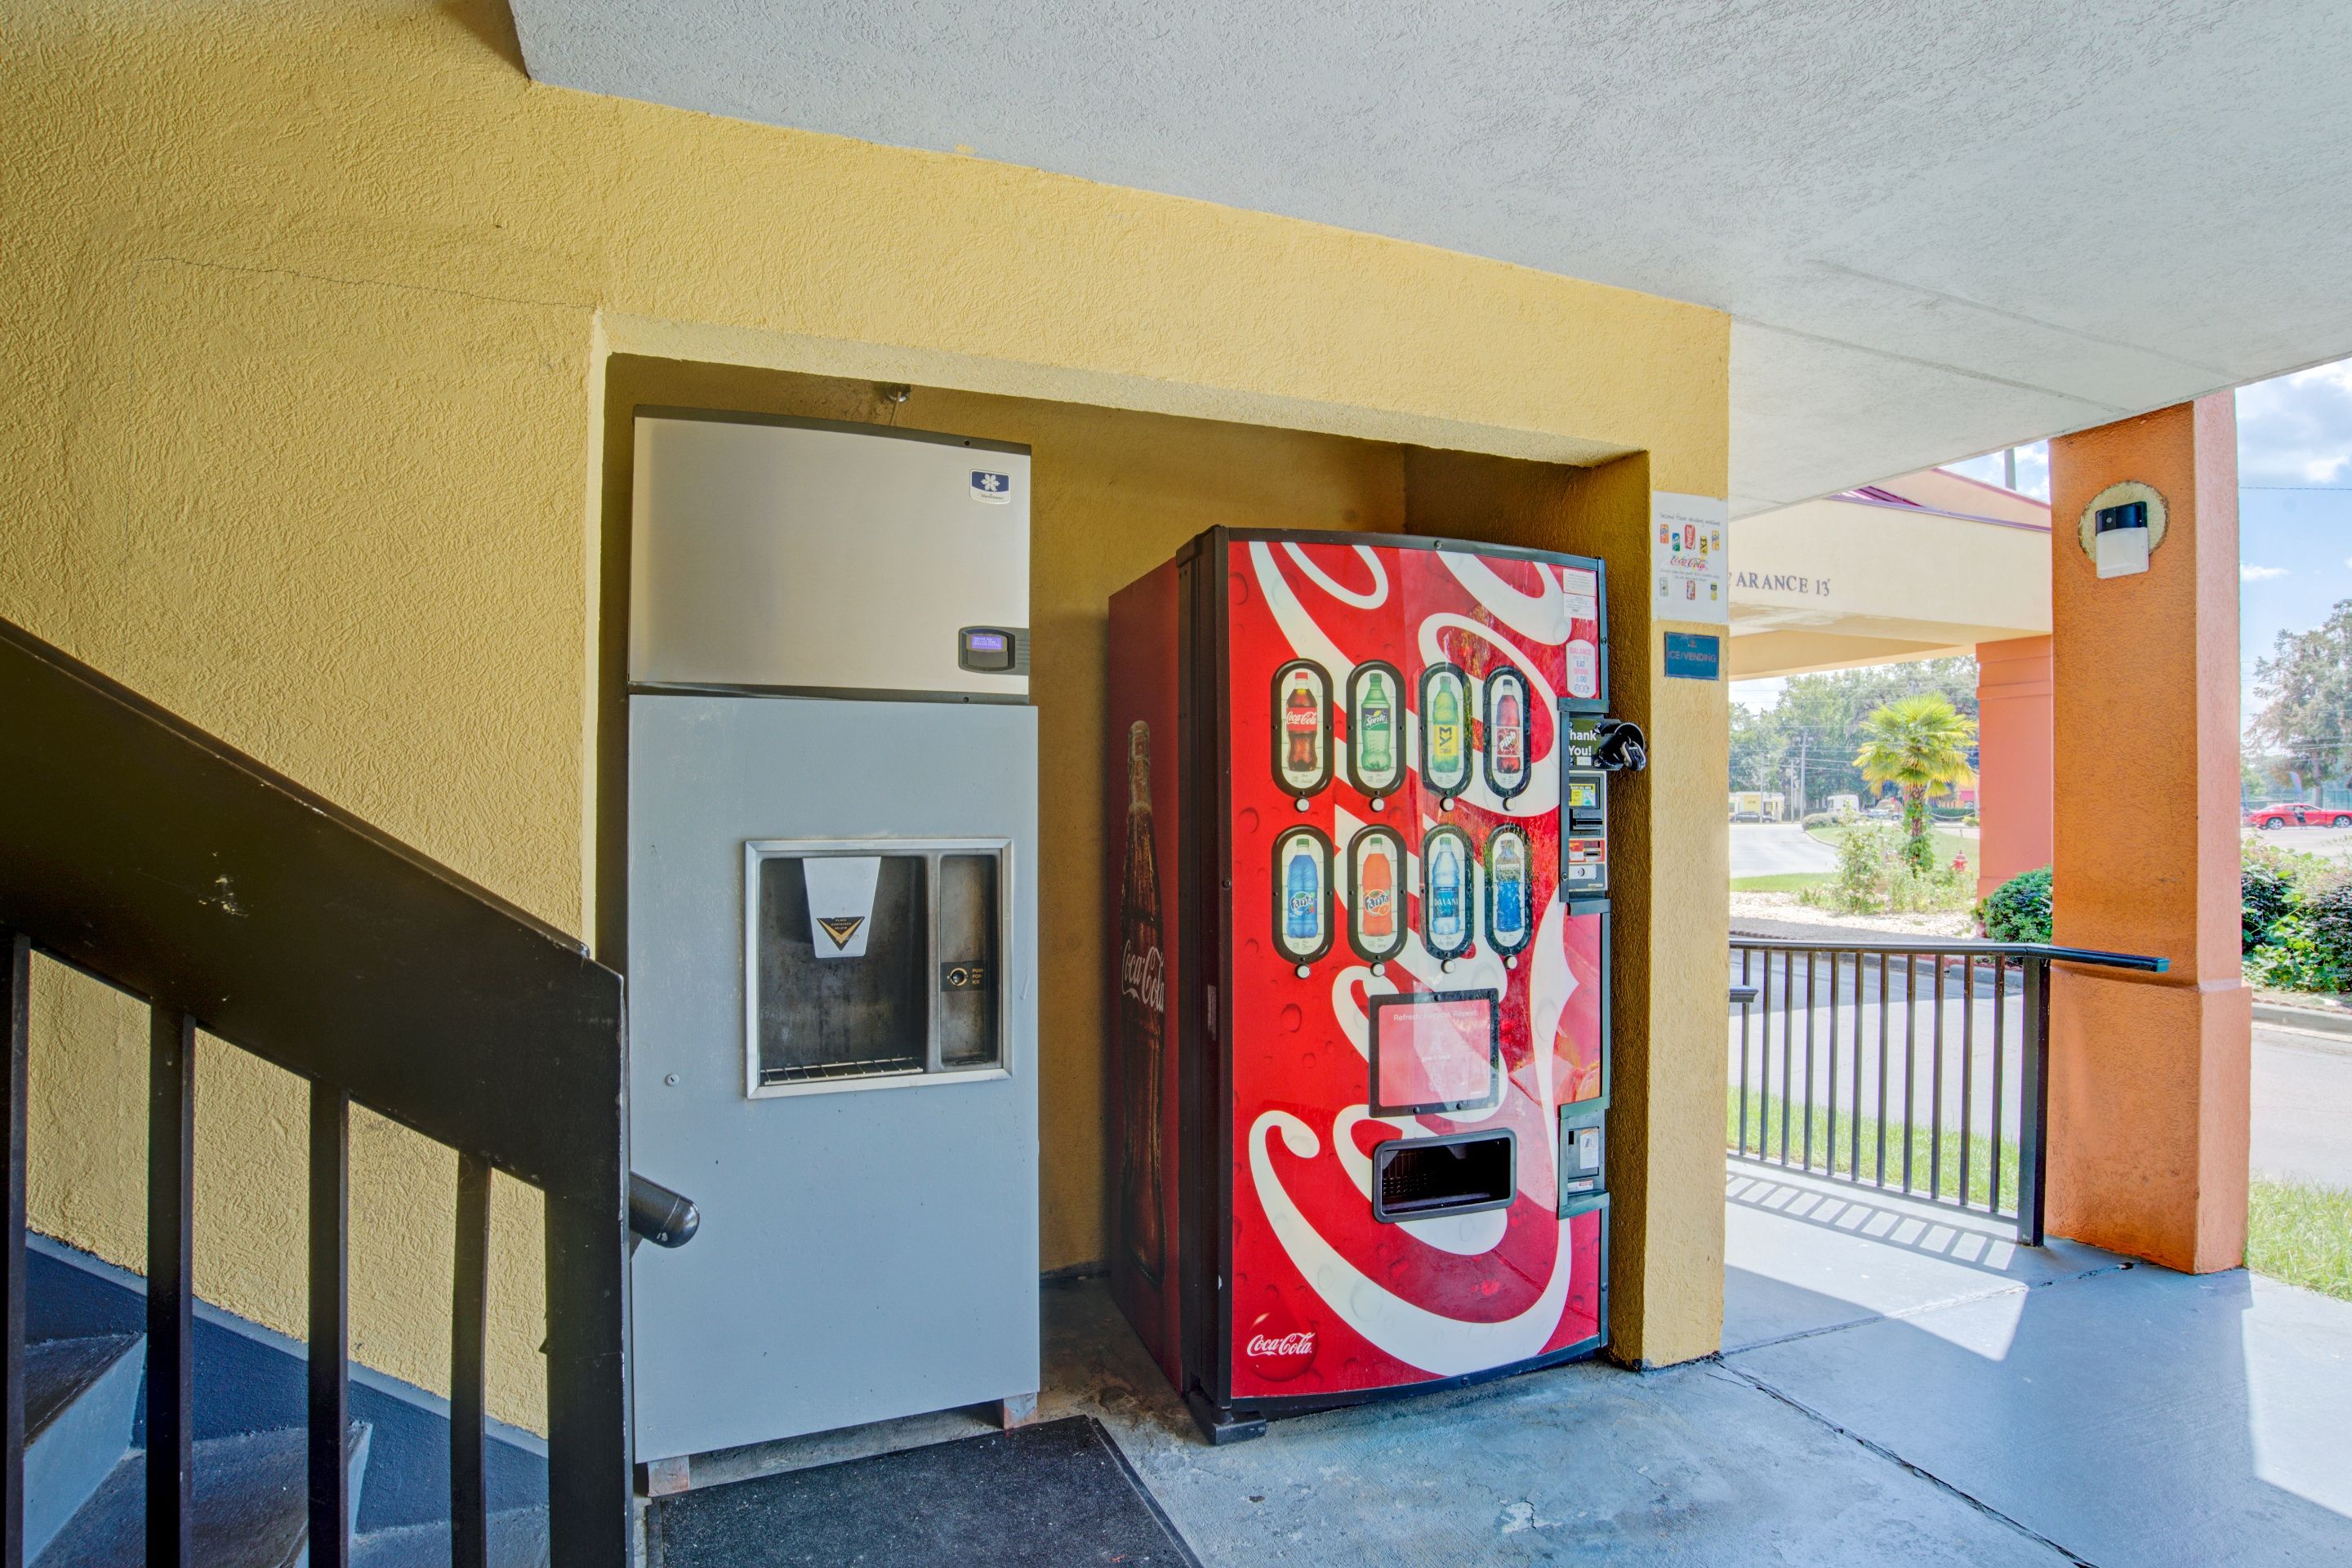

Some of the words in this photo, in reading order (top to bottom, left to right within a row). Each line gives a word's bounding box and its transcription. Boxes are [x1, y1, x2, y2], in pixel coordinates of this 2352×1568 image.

[1570, 647, 1592, 656] BALANCE
[1365, 714, 1386, 727] Sprite
[1569, 745, 1592, 756] You!
[1290, 894, 1313, 911] Fanta
[1365, 894, 1389, 911] Fanta
[1246, 1332, 1316, 1356] Coca-Cola
